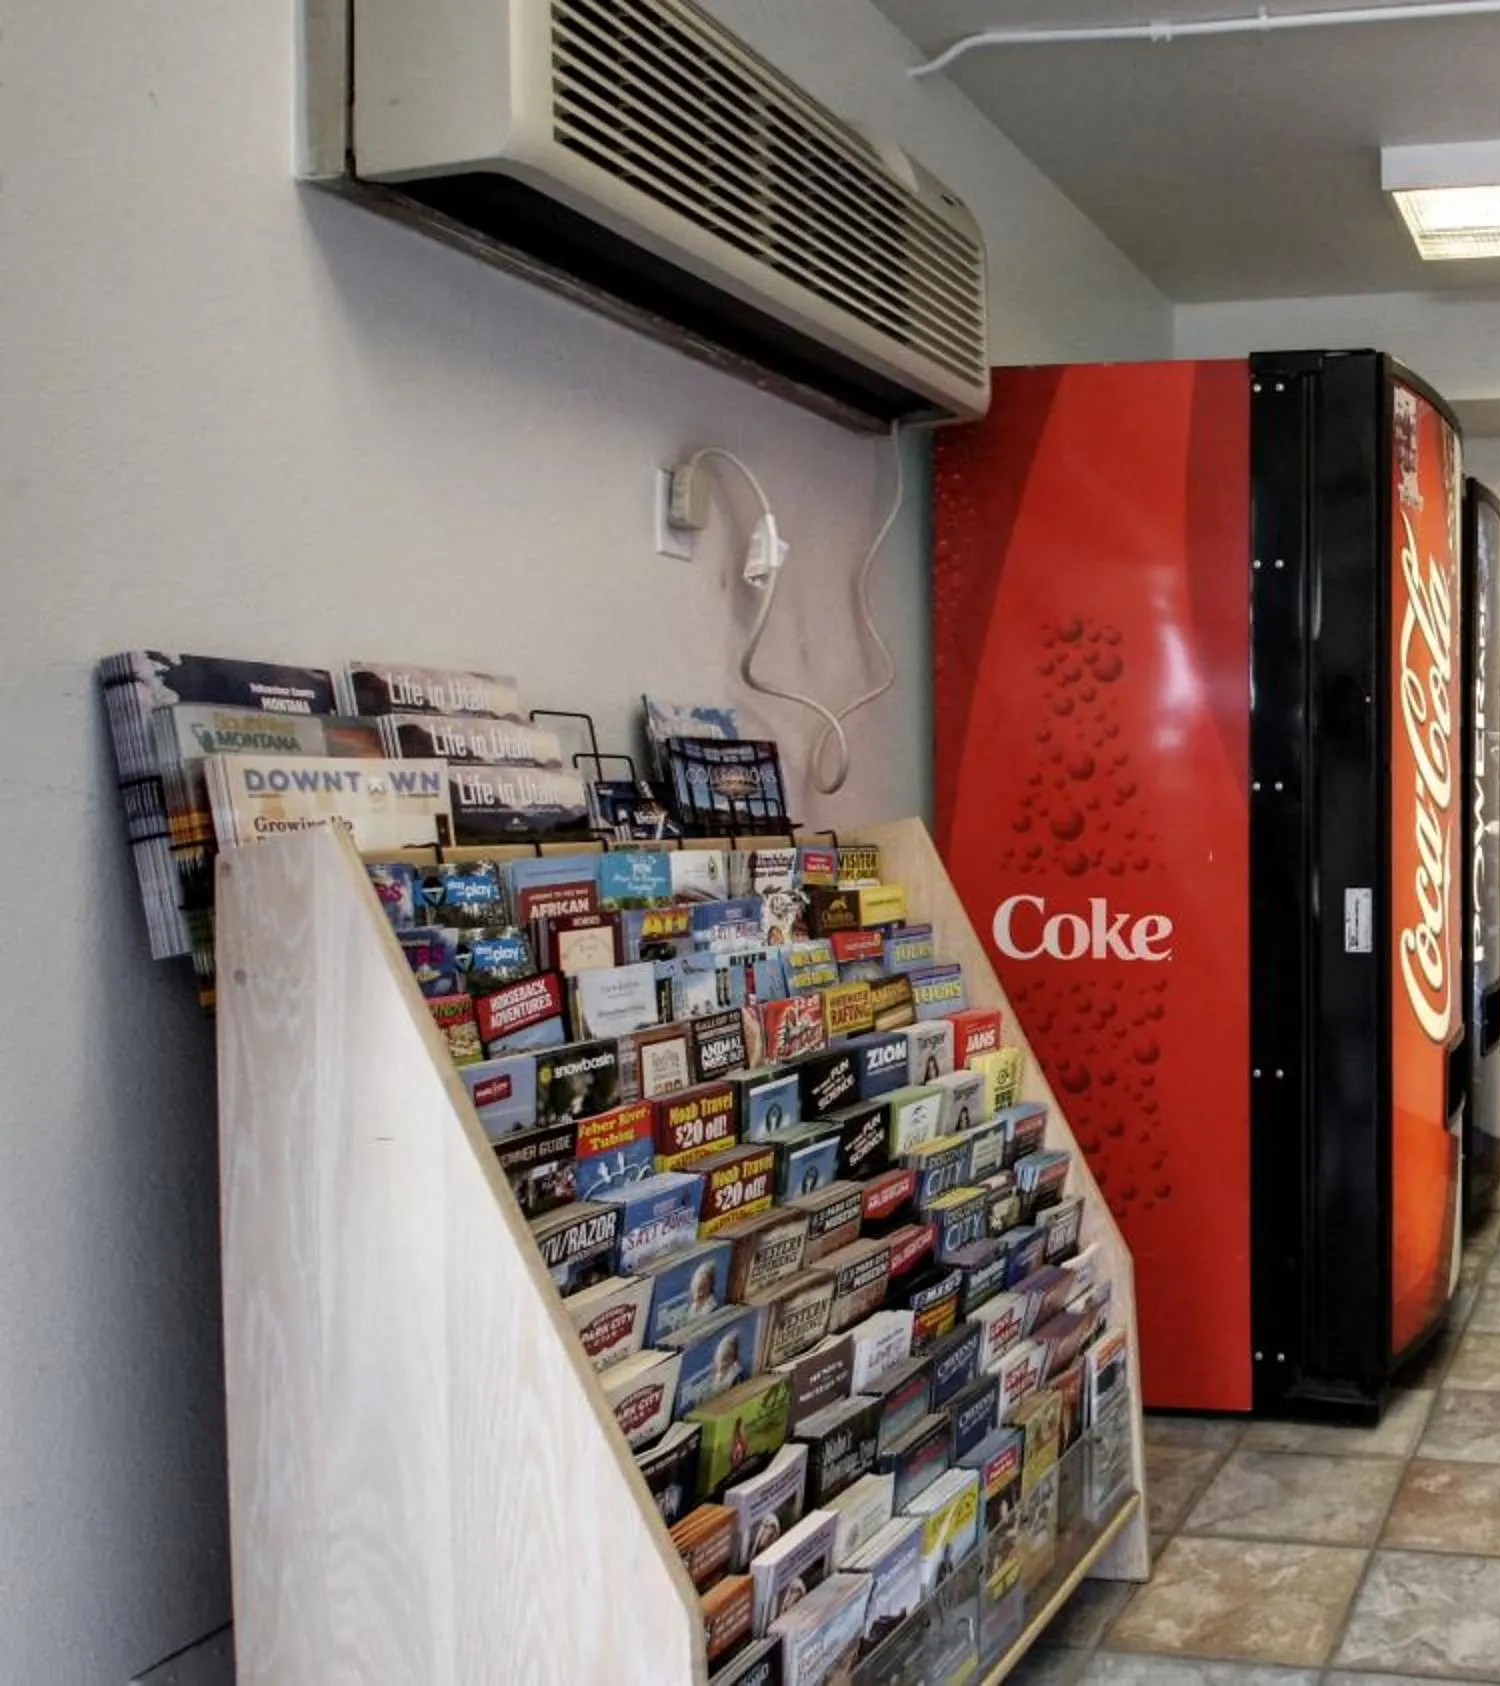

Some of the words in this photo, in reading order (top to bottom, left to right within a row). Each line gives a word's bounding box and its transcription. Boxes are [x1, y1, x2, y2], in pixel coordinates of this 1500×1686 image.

[388, 672, 424, 706] Life
[428, 686, 446, 709] in
[450, 680, 493, 711] Utah
[430, 723, 468, 757] Life
[471, 727, 488, 758] in
[456, 773, 495, 806] Life
[500, 783, 516, 806] in
[528, 897, 590, 920] AFRICAN
[993, 893, 1174, 962] Coke
[553, 1053, 616, 1079] snowbasin
[866, 1040, 908, 1071] ZION
[675, 1118, 704, 1149] $20
